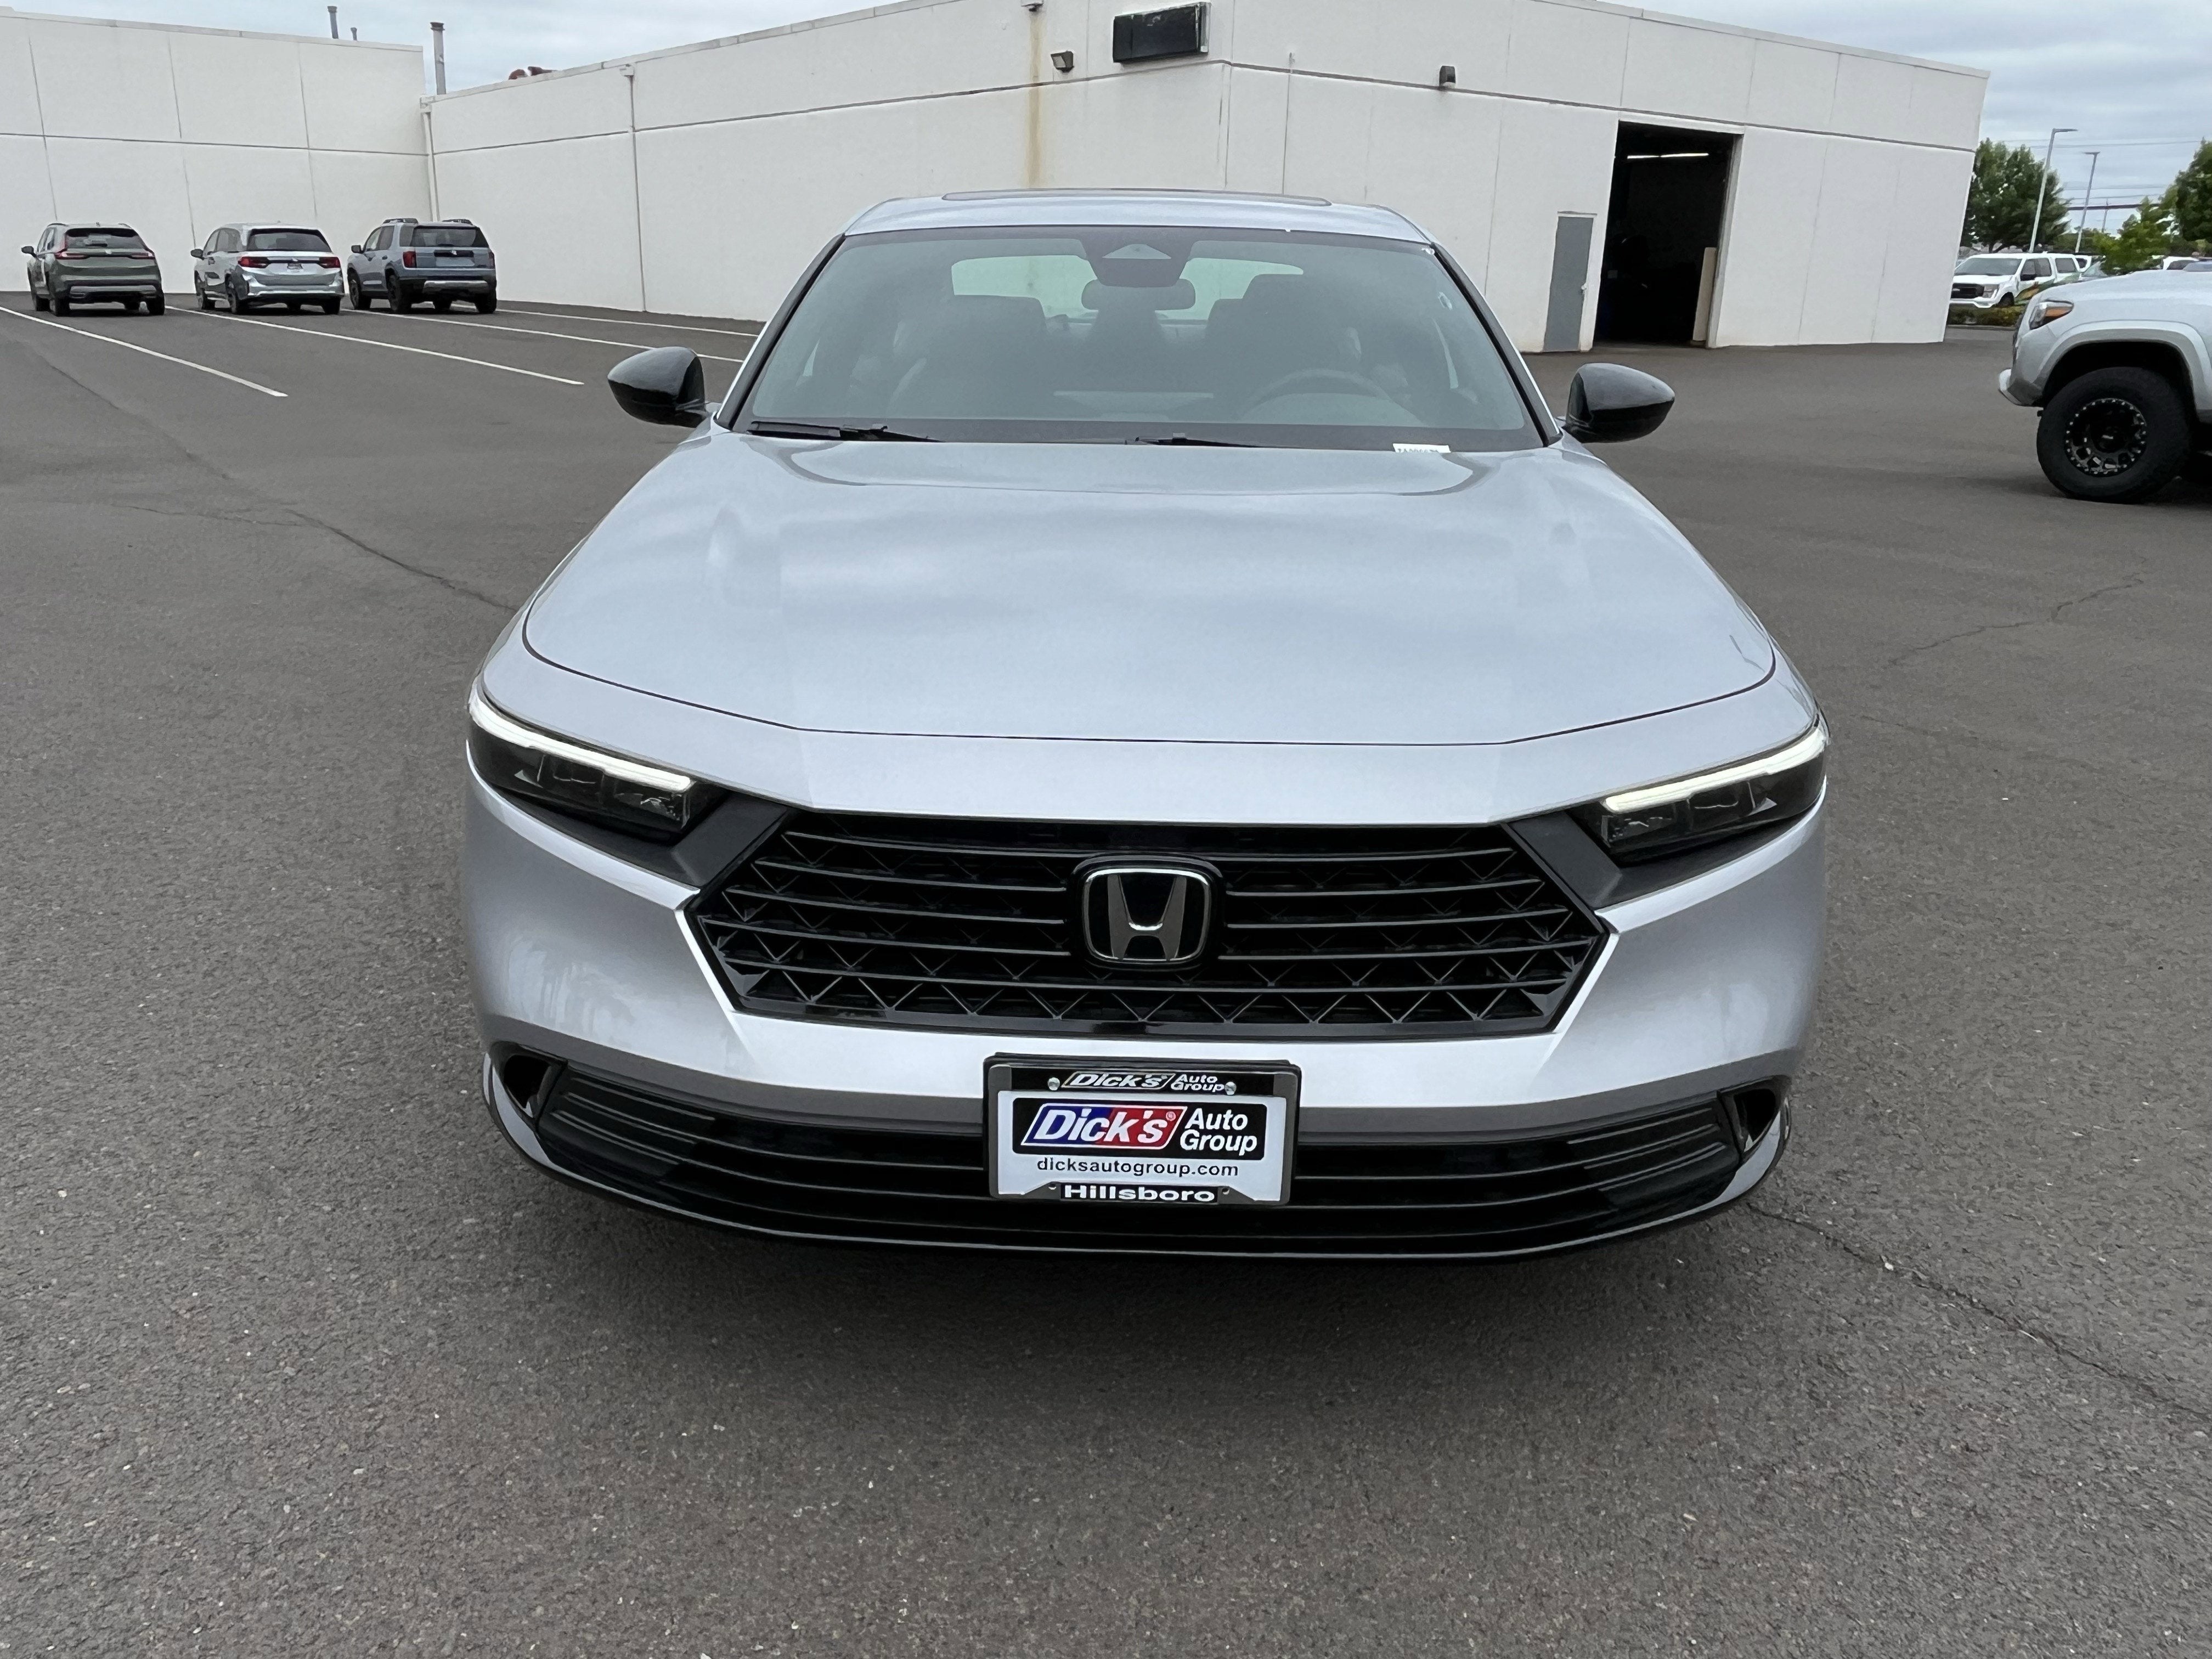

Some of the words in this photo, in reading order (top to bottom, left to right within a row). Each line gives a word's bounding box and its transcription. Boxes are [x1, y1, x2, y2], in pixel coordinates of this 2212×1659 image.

[1171, 1081, 1224, 1093] Group
[1175, 1074, 1218, 1084] Auto
[1184, 1108, 1248, 1130] Auto
[1180, 1129, 1257, 1156] Group
[1037, 1157, 1238, 1177] dicksautogroup.com
[1064, 1184, 1215, 1201] Hillsboro
